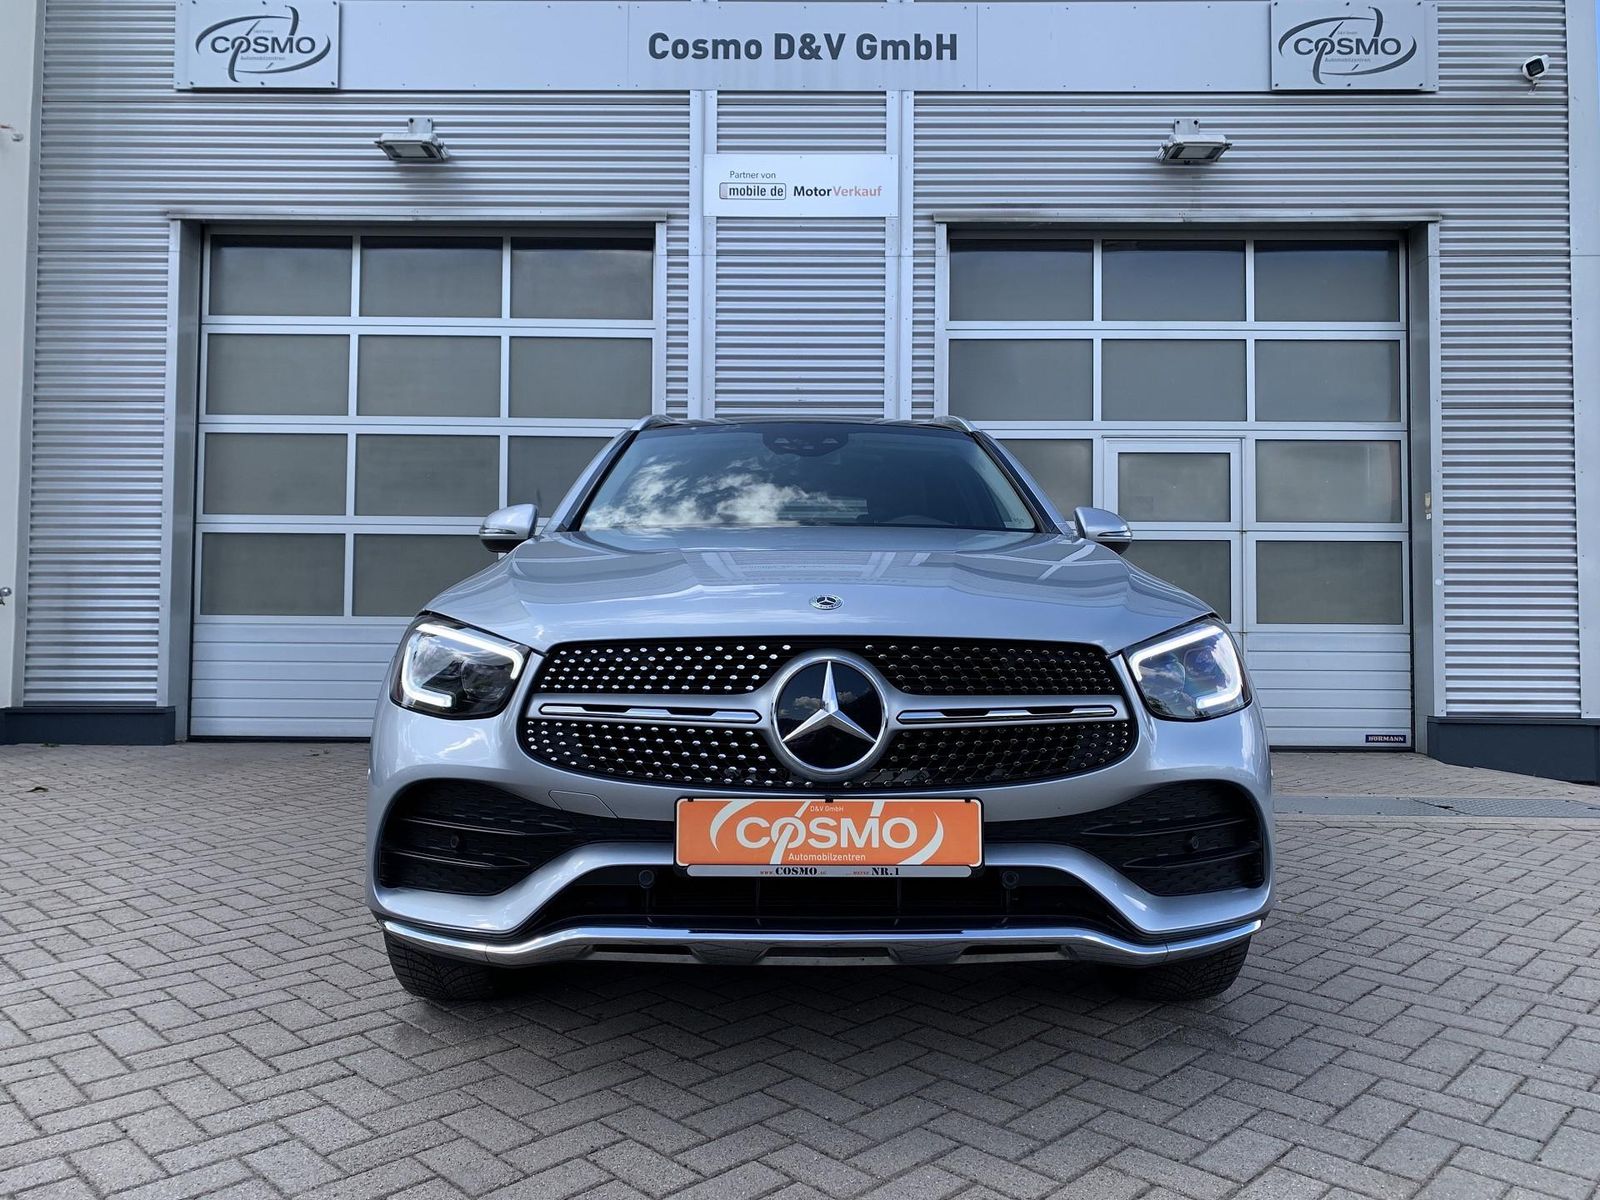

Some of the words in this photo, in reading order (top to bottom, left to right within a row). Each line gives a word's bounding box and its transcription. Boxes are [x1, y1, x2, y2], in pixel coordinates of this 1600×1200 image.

[210, 36, 316, 54] COSMO
[648, 32, 763, 60] Cosmo
[773, 32, 846, 60] D&V
[856, 33, 958, 61] GmbH
[1293, 37, 1402, 55] COSMO
[729, 170, 759, 179] Partner
[735, 816, 918, 849] COSMO
[788, 852, 866, 862] Automobilzentren
